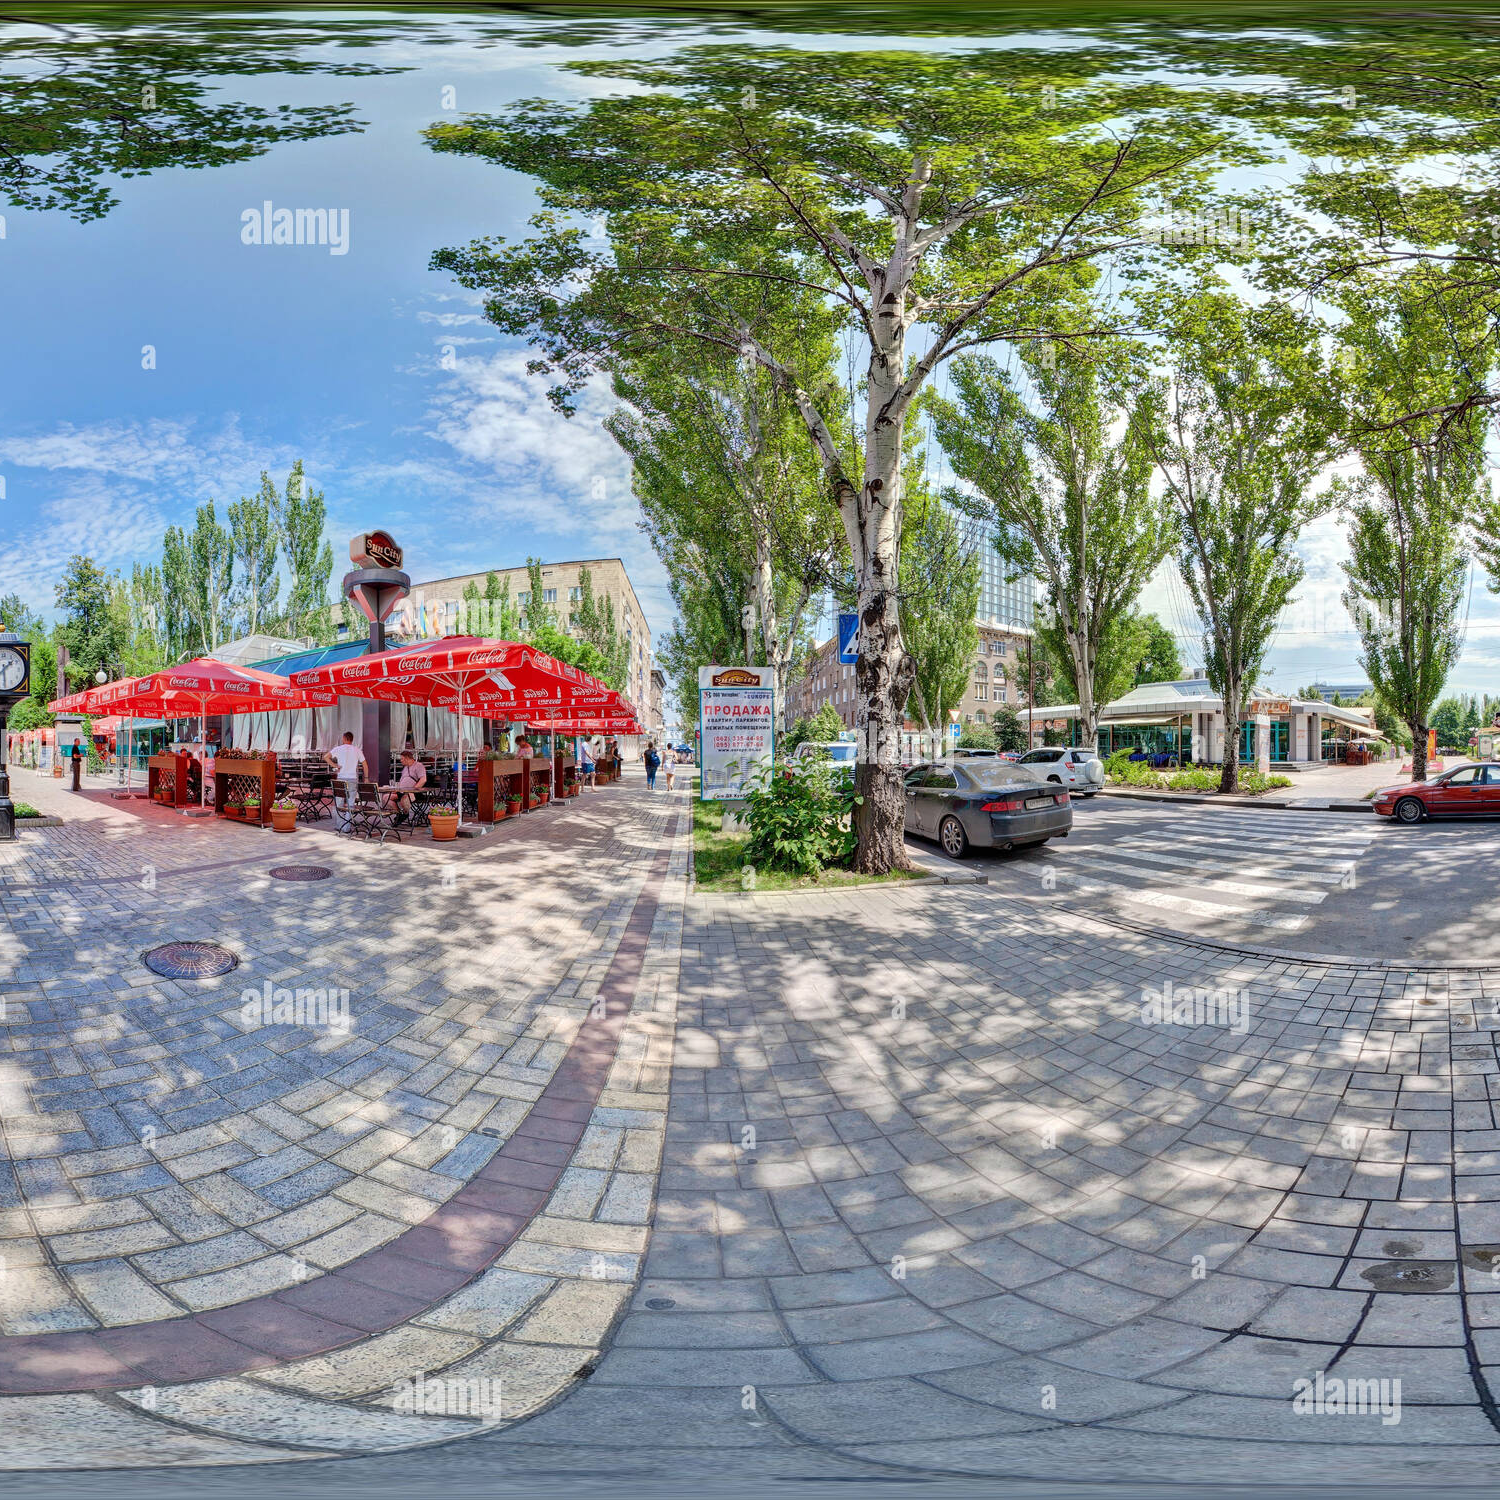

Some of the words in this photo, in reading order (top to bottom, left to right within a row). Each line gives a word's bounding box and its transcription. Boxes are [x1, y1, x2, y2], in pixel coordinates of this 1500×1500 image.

[467, 648, 510, 666] Coca-Cola
[342, 664, 371, 677] Coca-Cola
[398, 656, 433, 672] Coca-Cola
[169, 677, 200, 688] Coca-Cola
[297, 671, 320, 685] Coca-Cola
[223, 681, 250, 692] Coca-Cola
[704, 705, 771, 717] ПРОДАЖА
